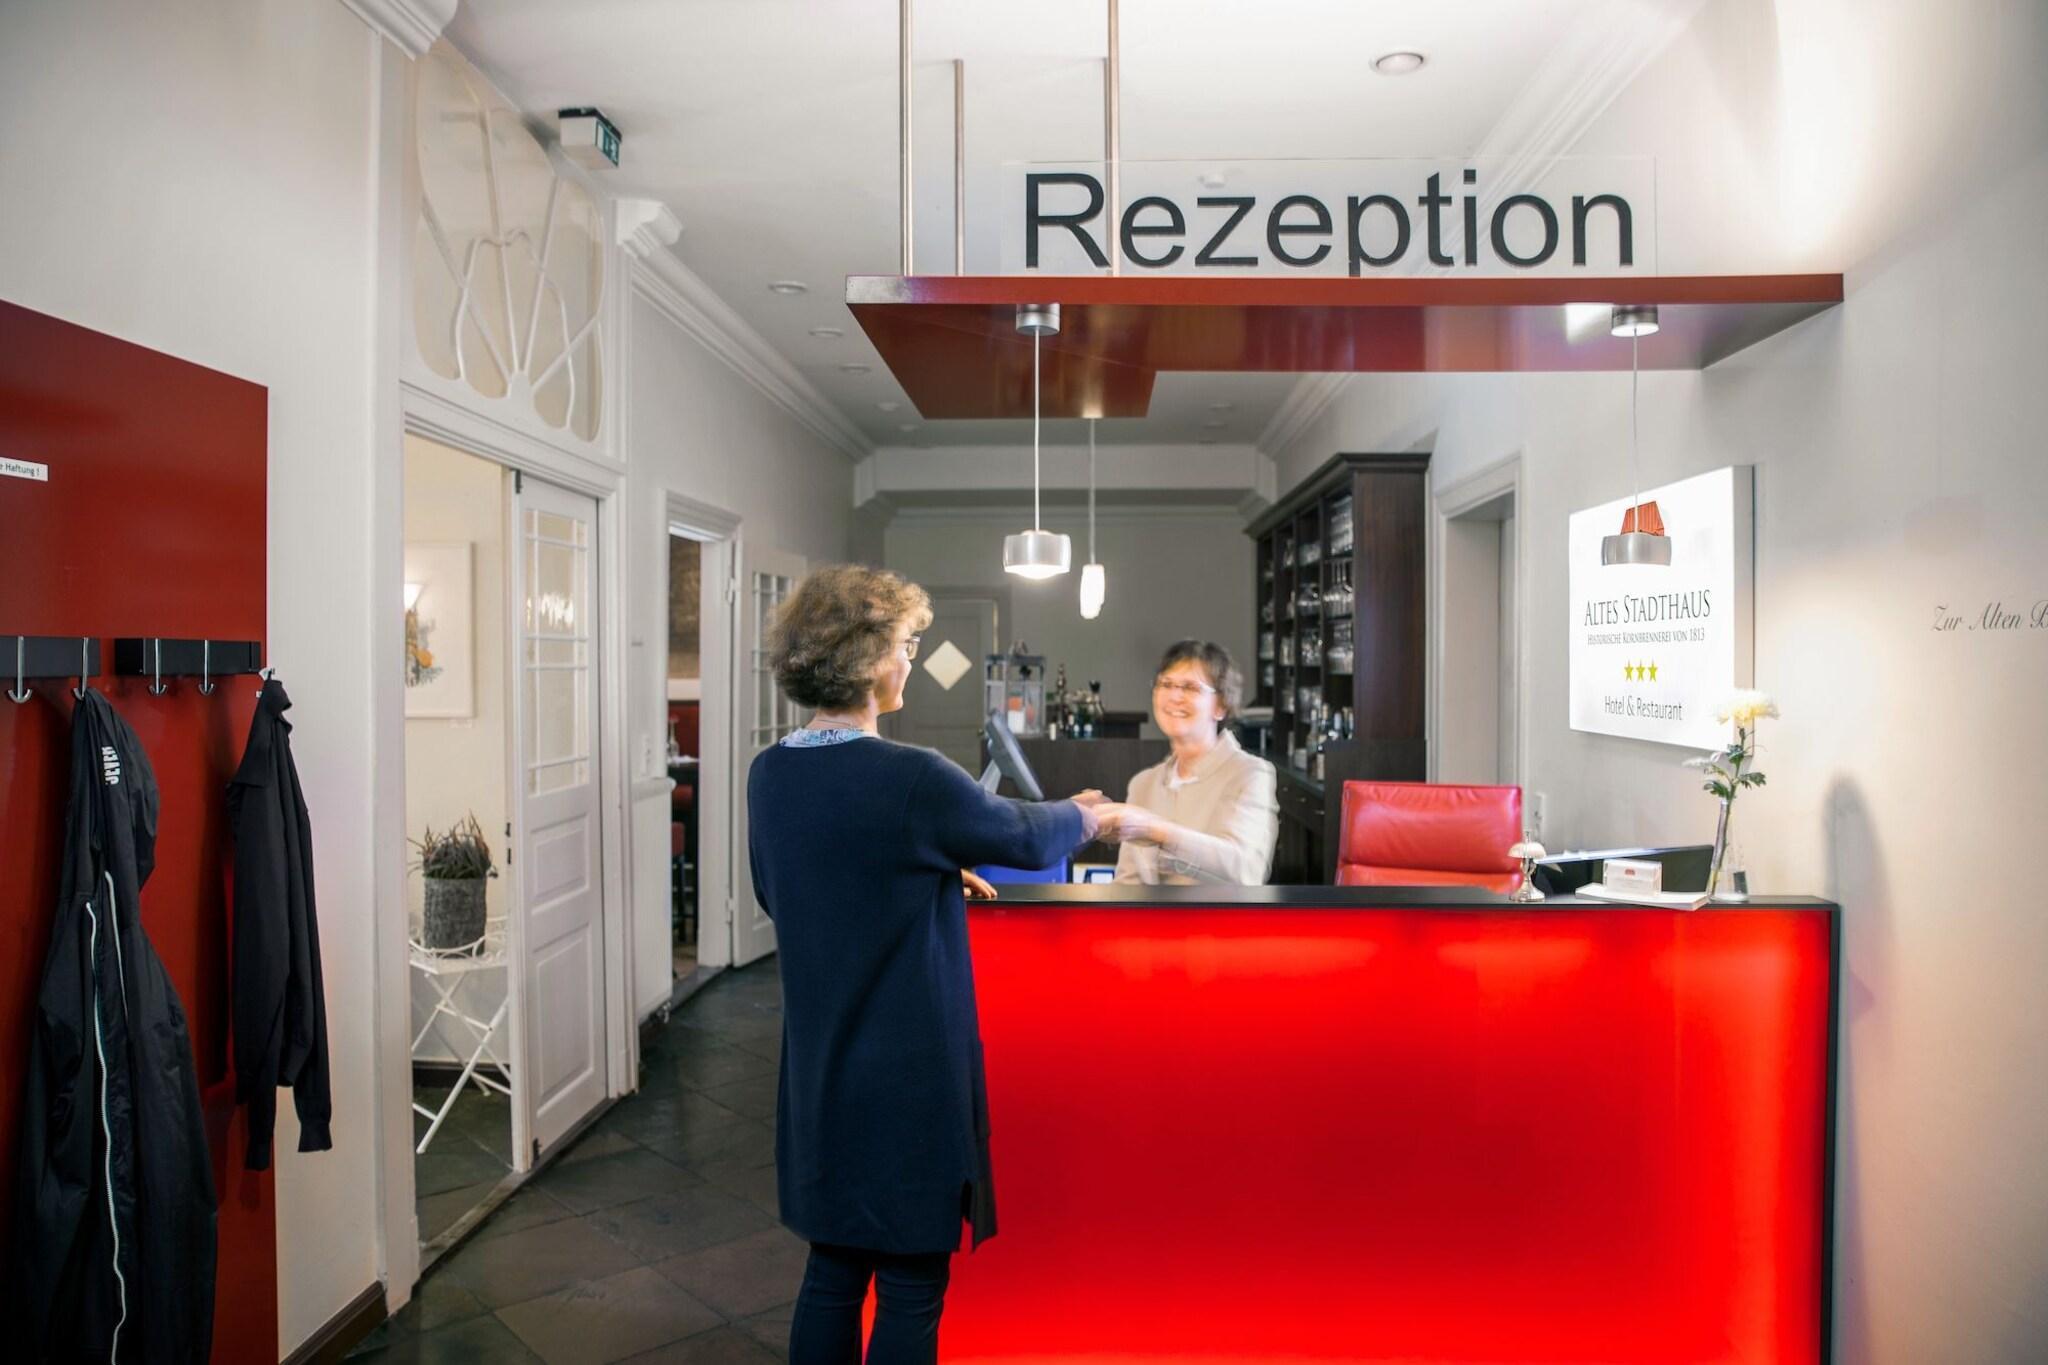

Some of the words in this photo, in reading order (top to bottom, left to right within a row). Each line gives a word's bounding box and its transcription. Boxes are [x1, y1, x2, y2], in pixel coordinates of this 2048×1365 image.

[1025, 169, 1634, 277] Rezeption
[5, 462, 35, 477] Haftung
[1931, 604, 1963, 631] Zur
[1968, 602, 2021, 630] Alten
[1690, 628, 1705, 641] 1813
[1604, 696, 1624, 715] Hotel
[1627, 695, 1635, 716] &
[1636, 697, 1682, 720] Restaurant
